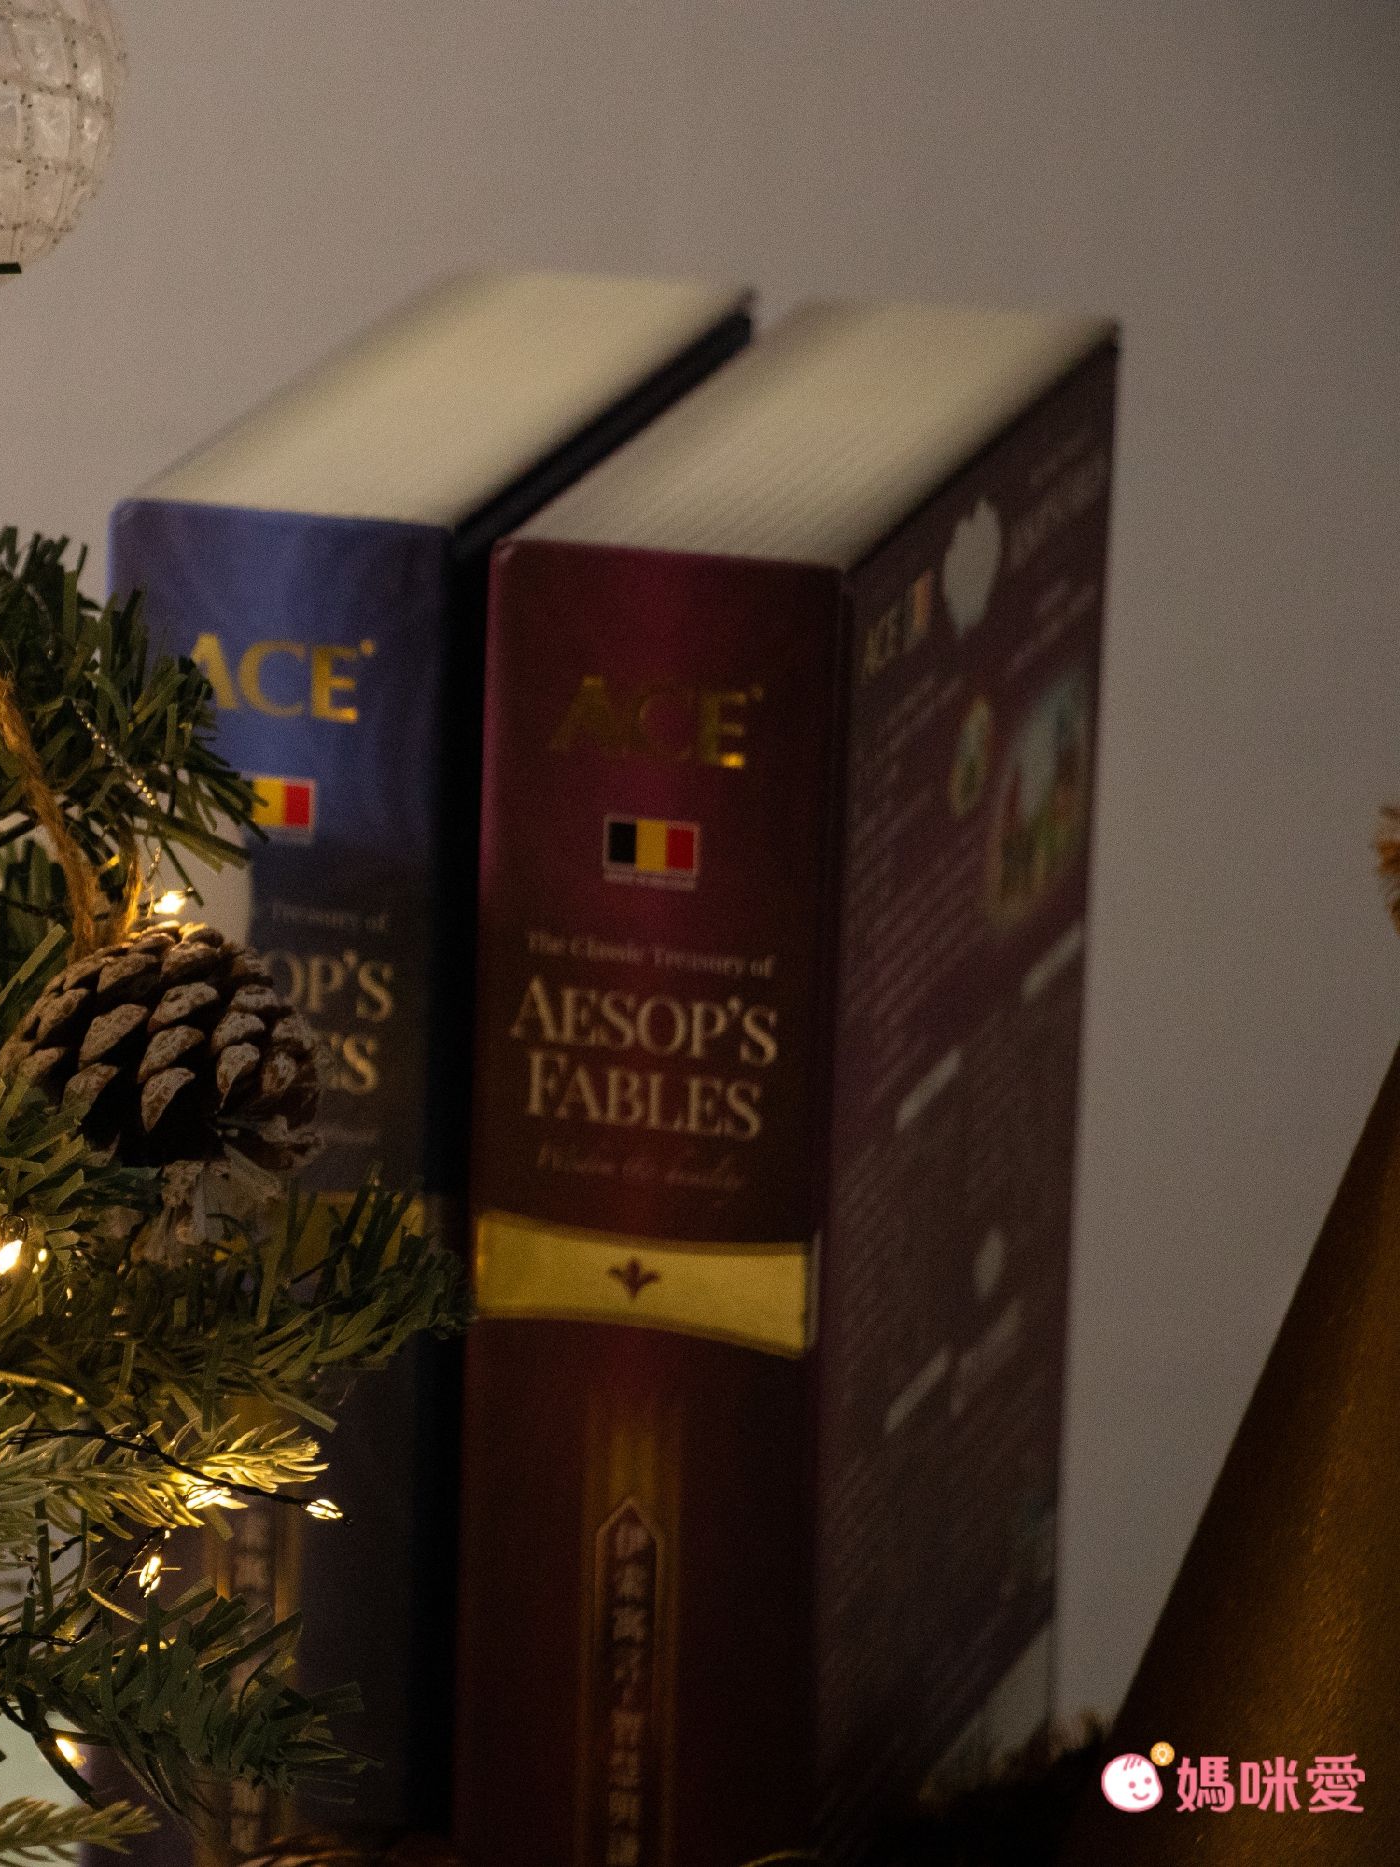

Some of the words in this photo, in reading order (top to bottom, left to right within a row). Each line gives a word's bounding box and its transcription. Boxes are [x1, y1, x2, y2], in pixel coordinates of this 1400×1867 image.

[189, 632, 360, 724] ACE
[549, 674, 746, 770] ACE
[263, 947, 396, 1023] OP'S
[509, 974, 780, 1068] AESOP'S
[524, 1048, 764, 1141] FABLES
